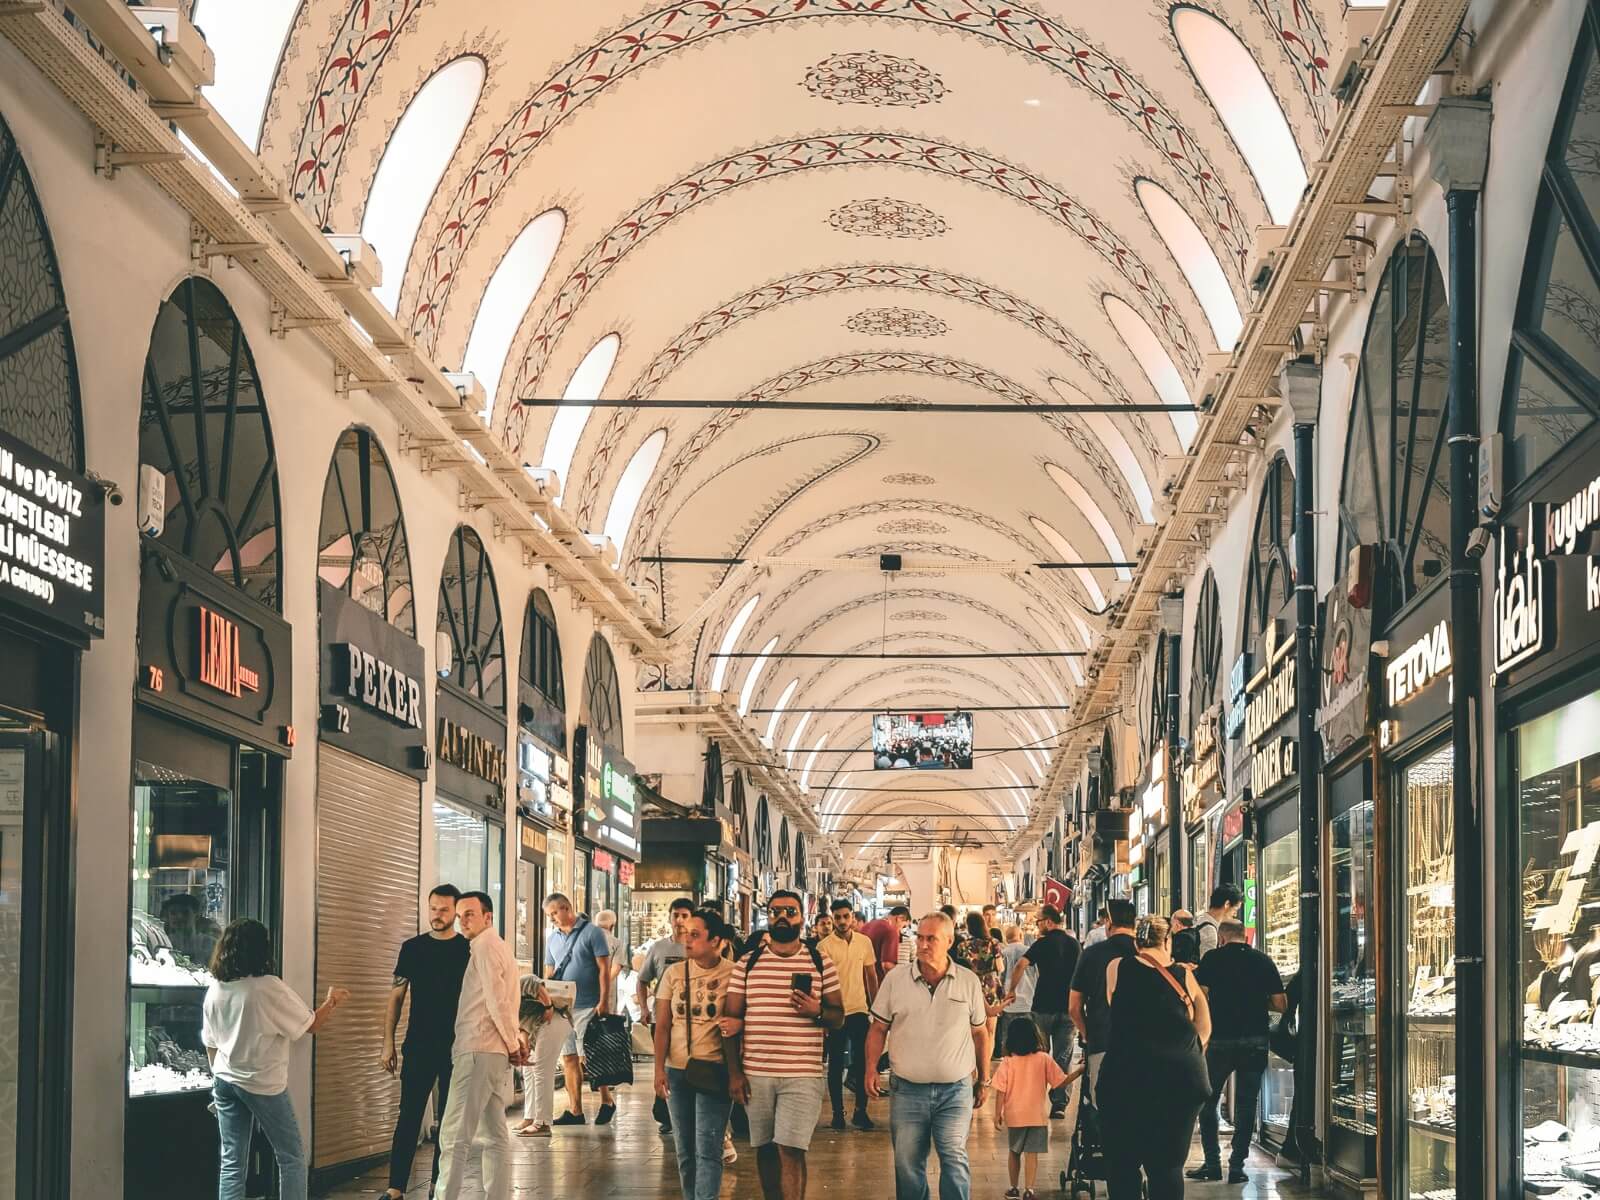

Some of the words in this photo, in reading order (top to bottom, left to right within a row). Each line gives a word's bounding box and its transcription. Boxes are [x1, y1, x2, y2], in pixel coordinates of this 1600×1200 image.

[15, 463, 34, 491] ve
[35, 469, 82, 517] DÖVİZ
[16, 533, 93, 592] MÜESSESE
[149, 665, 163, 692] 76
[200, 606, 241, 698] LEMA
[1386, 620, 1452, 708] TETOVA
[348, 642, 422, 729] PEKER
[1244, 655, 1296, 748] KARADENİZ
[336, 703, 350, 734] 72
[1251, 736, 1283, 800] ÖRNEK
